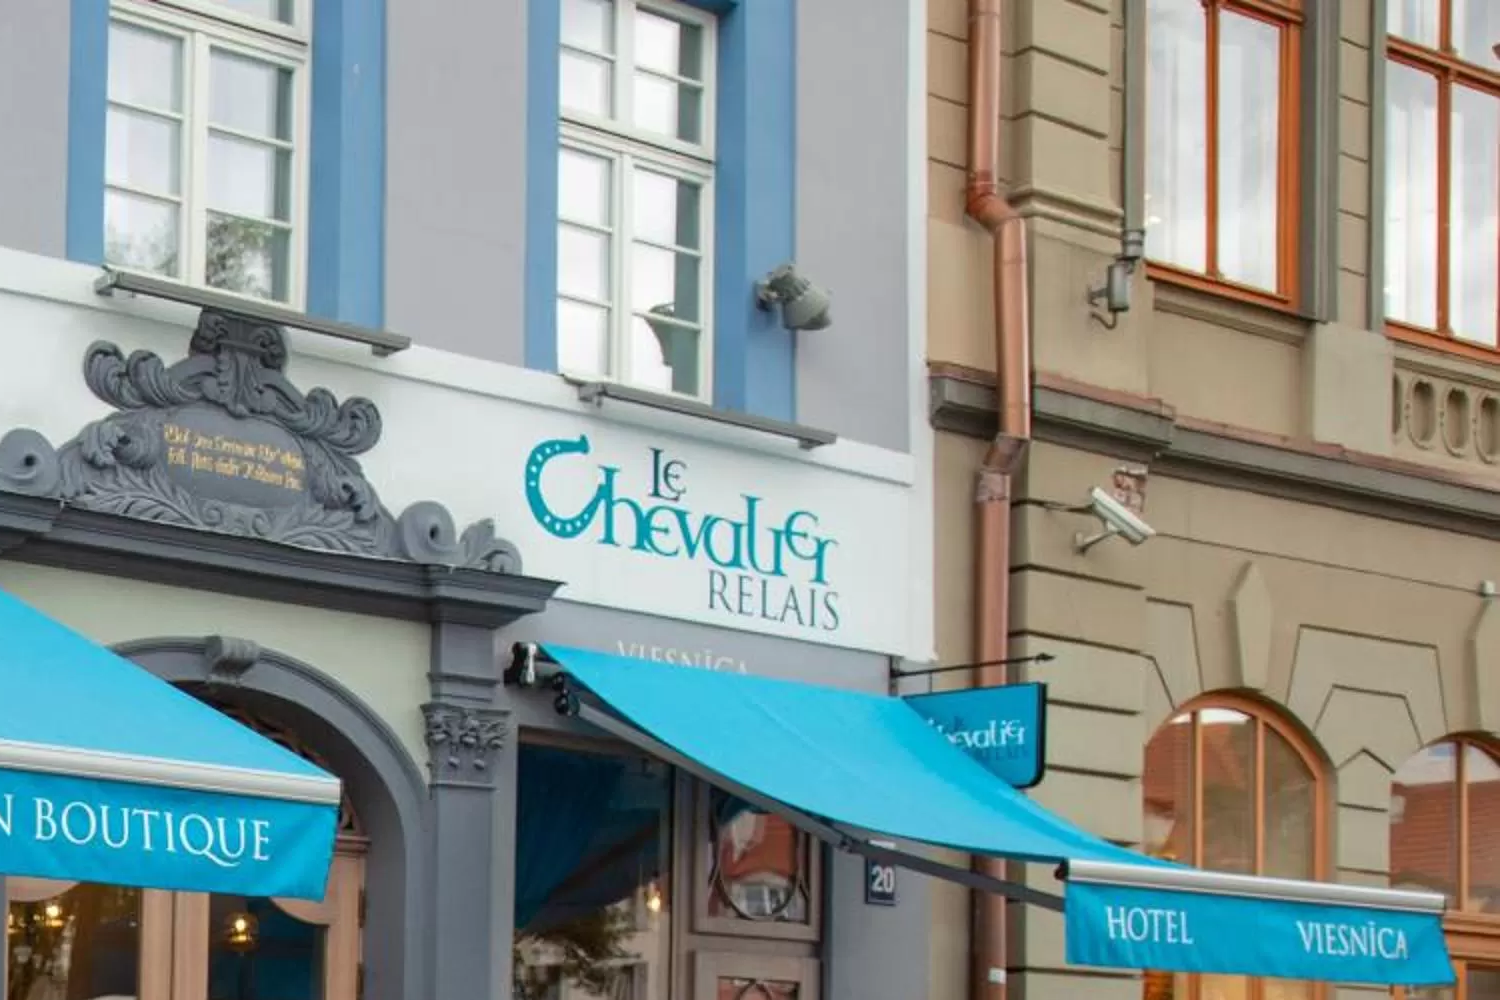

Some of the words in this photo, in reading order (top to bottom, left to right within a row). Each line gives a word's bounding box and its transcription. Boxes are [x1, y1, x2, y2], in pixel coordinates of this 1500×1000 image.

[525, 434, 838, 585] Chevalier
[707, 569, 840, 631] RELAIS
[35, 797, 269, 868] BOUTIQUE
[871, 865, 894, 893] 20
[1105, 905, 1193, 944] HOTEL
[1296, 920, 1409, 960] VIESNĪCA
